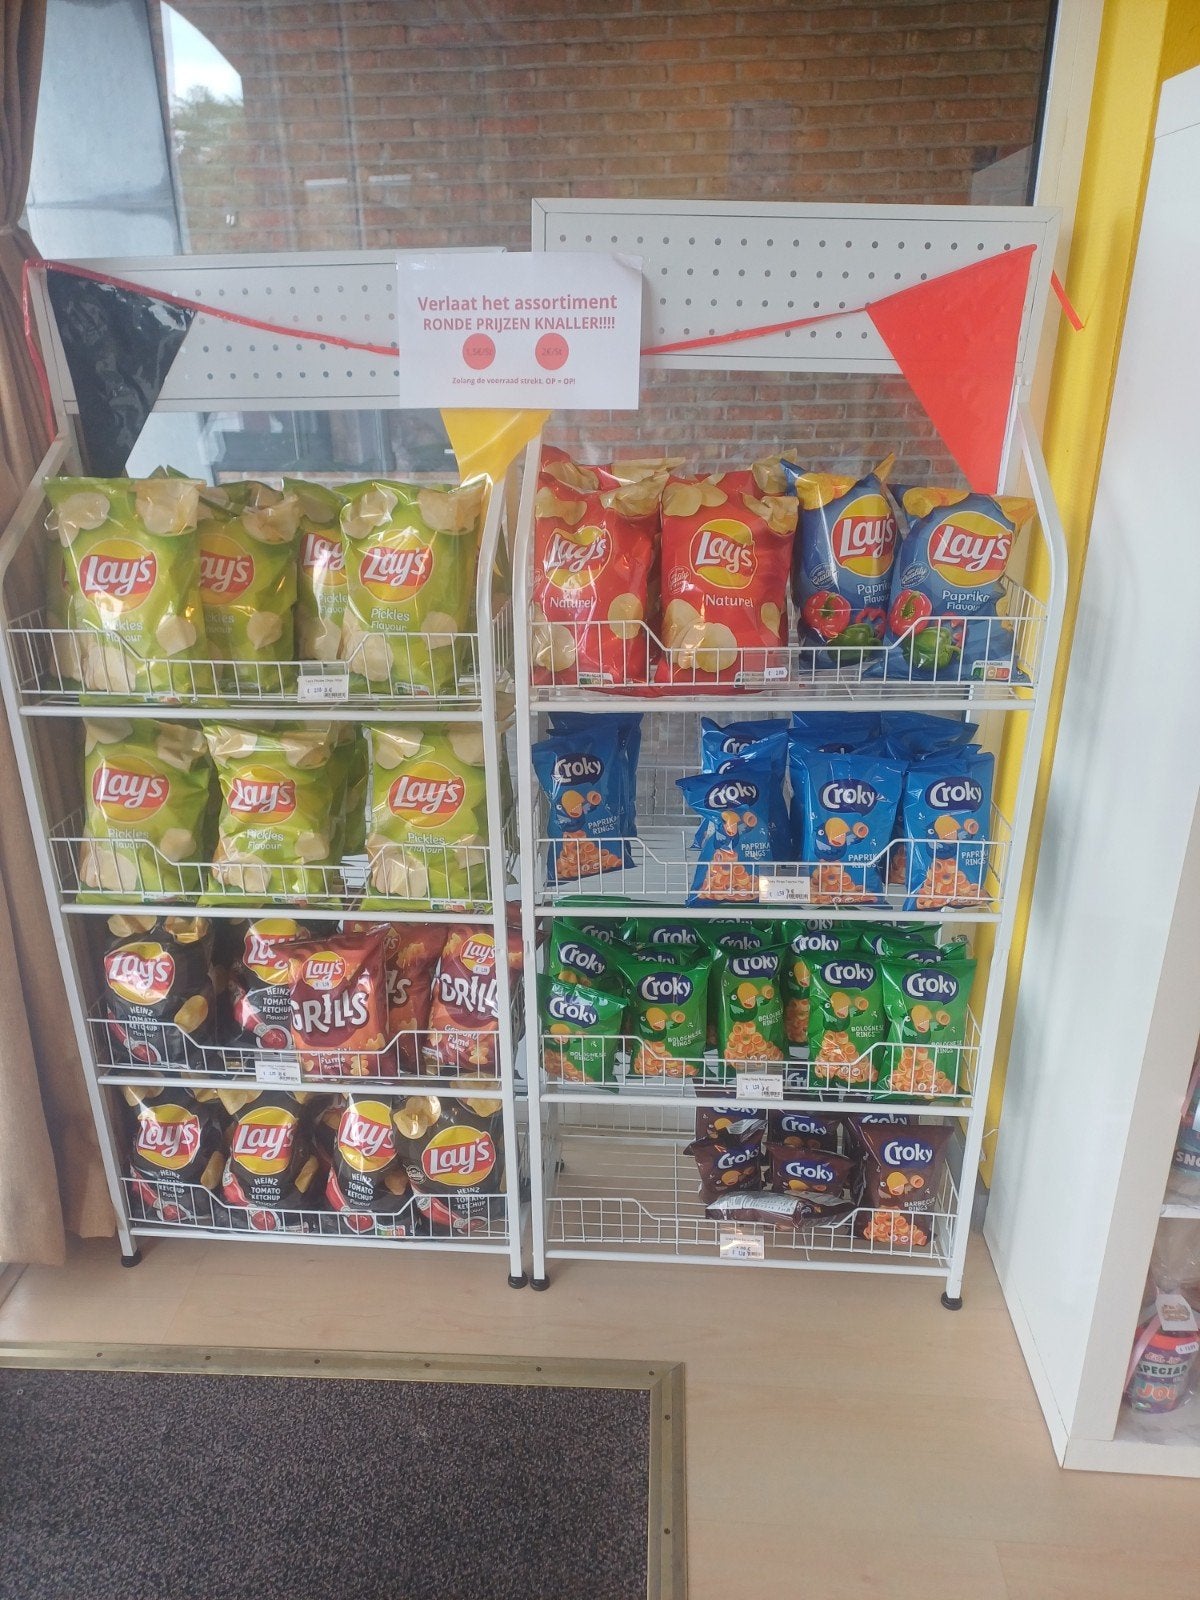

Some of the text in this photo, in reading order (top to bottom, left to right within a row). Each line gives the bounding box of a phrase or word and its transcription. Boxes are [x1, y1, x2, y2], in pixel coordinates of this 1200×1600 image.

[418, 294, 618, 311] Verlaat het assortiment
[424, 316, 616, 333] RONDE PRIJZEN KNALLER!!!!
[452, 378, 474, 386] Zolang
[840, 514, 895, 560] Lay's
[303, 534, 346, 570] Lay
[696, 532, 753, 573] Lay's
[934, 525, 1010, 572] Lay's
[85, 554, 154, 596] Lay's
[201, 555, 250, 592] ay's
[364, 548, 428, 587] Lay's
[857, 580, 888, 595] Papri
[319, 592, 349, 604] Pickle
[550, 596, 596, 608] Naturel
[706, 594, 754, 608] Naturel
[864, 594, 889, 605] Flavo
[320, 606, 347, 614] Flavo
[372, 608, 410, 622] Pickles
[104, 618, 144, 632] ckles
[106, 631, 142, 642] Flaour
[554, 757, 602, 783] Croky
[394, 776, 462, 814] Lay's
[708, 781, 757, 808] Croky
[822, 783, 875, 808] Croky
[930, 782, 982, 807] Croky
[108, 828, 149, 840] Pickles
[247, 829, 284, 841] Pickles
[592, 824, 615, 835] RINGS
[408, 832, 445, 845] Pickles
[742, 842, 770, 851] PAPRIKA
[806, 918, 834, 930] oky
[791, 934, 840, 954] Croky
[560, 944, 605, 974] Croky
[733, 954, 778, 975] Croky
[109, 955, 170, 990] Lay's
[306, 960, 343, 982] Lay's
[824, 962, 874, 985] Croky
[267, 987, 290, 996] HEINZ
[642, 976, 690, 1000] Croky
[906, 972, 957, 997] Croky
[130, 1006, 154, 1016] HEINZ
[292, 992, 368, 1034] GRILLS
[550, 997, 597, 1025] Croky
[762, 1017, 780, 1027] RINGS
[851, 1025, 884, 1033] BOLOGNESE
[668, 1030, 702, 1042] BOLOGNESE
[672, 1040, 692, 1048] RINGS
[782, 1116, 827, 1136] Croky
[138, 1119, 195, 1158] Lay's
[235, 1122, 293, 1160] Lay's
[341, 1114, 395, 1157] Lays
[430, 1140, 490, 1175] Lay's
[718, 1148, 760, 1169] Croky
[884, 1142, 932, 1165] Croky
[160, 1170, 180, 1179] HEINZ
[352, 1172, 373, 1186] HEINZ
[786, 1162, 834, 1182] Croky
[252, 1186, 281, 1195] TOMATO
[254, 1178, 279, 1186] HEINZ
[348, 1182, 374, 1196] TOMATO
[457, 1186, 480, 1195] HEINZ
[348, 1190, 374, 1201] KETCHUP
[457, 1200, 486, 1210] KETCHUP
